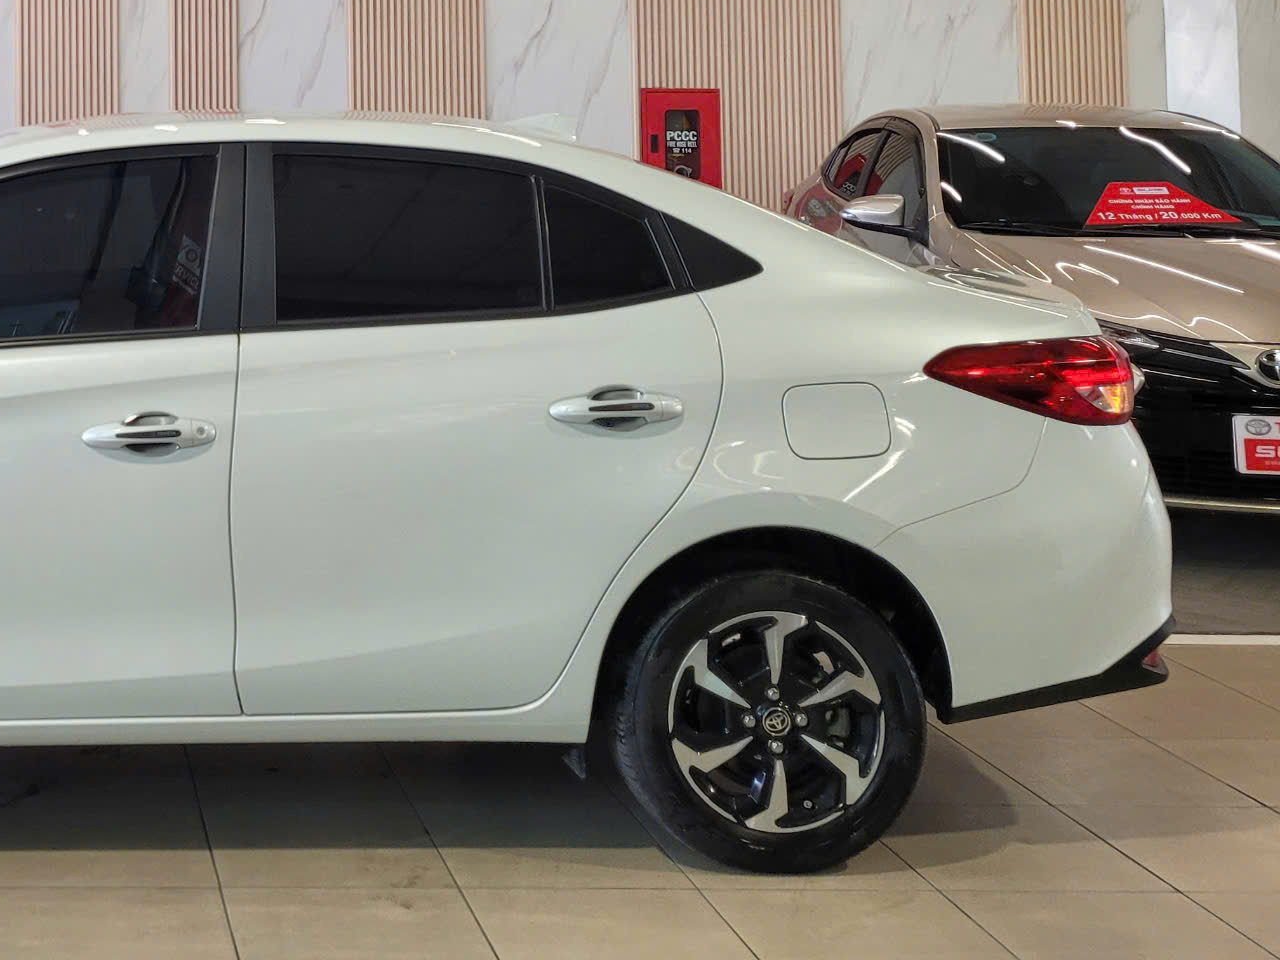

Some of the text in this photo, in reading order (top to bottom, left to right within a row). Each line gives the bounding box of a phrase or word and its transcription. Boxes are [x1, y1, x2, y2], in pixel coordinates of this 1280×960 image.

[666, 130, 698, 141] PCCC
[1097, 212, 1116, 220] 12
[1202, 212, 1222, 220] Km
